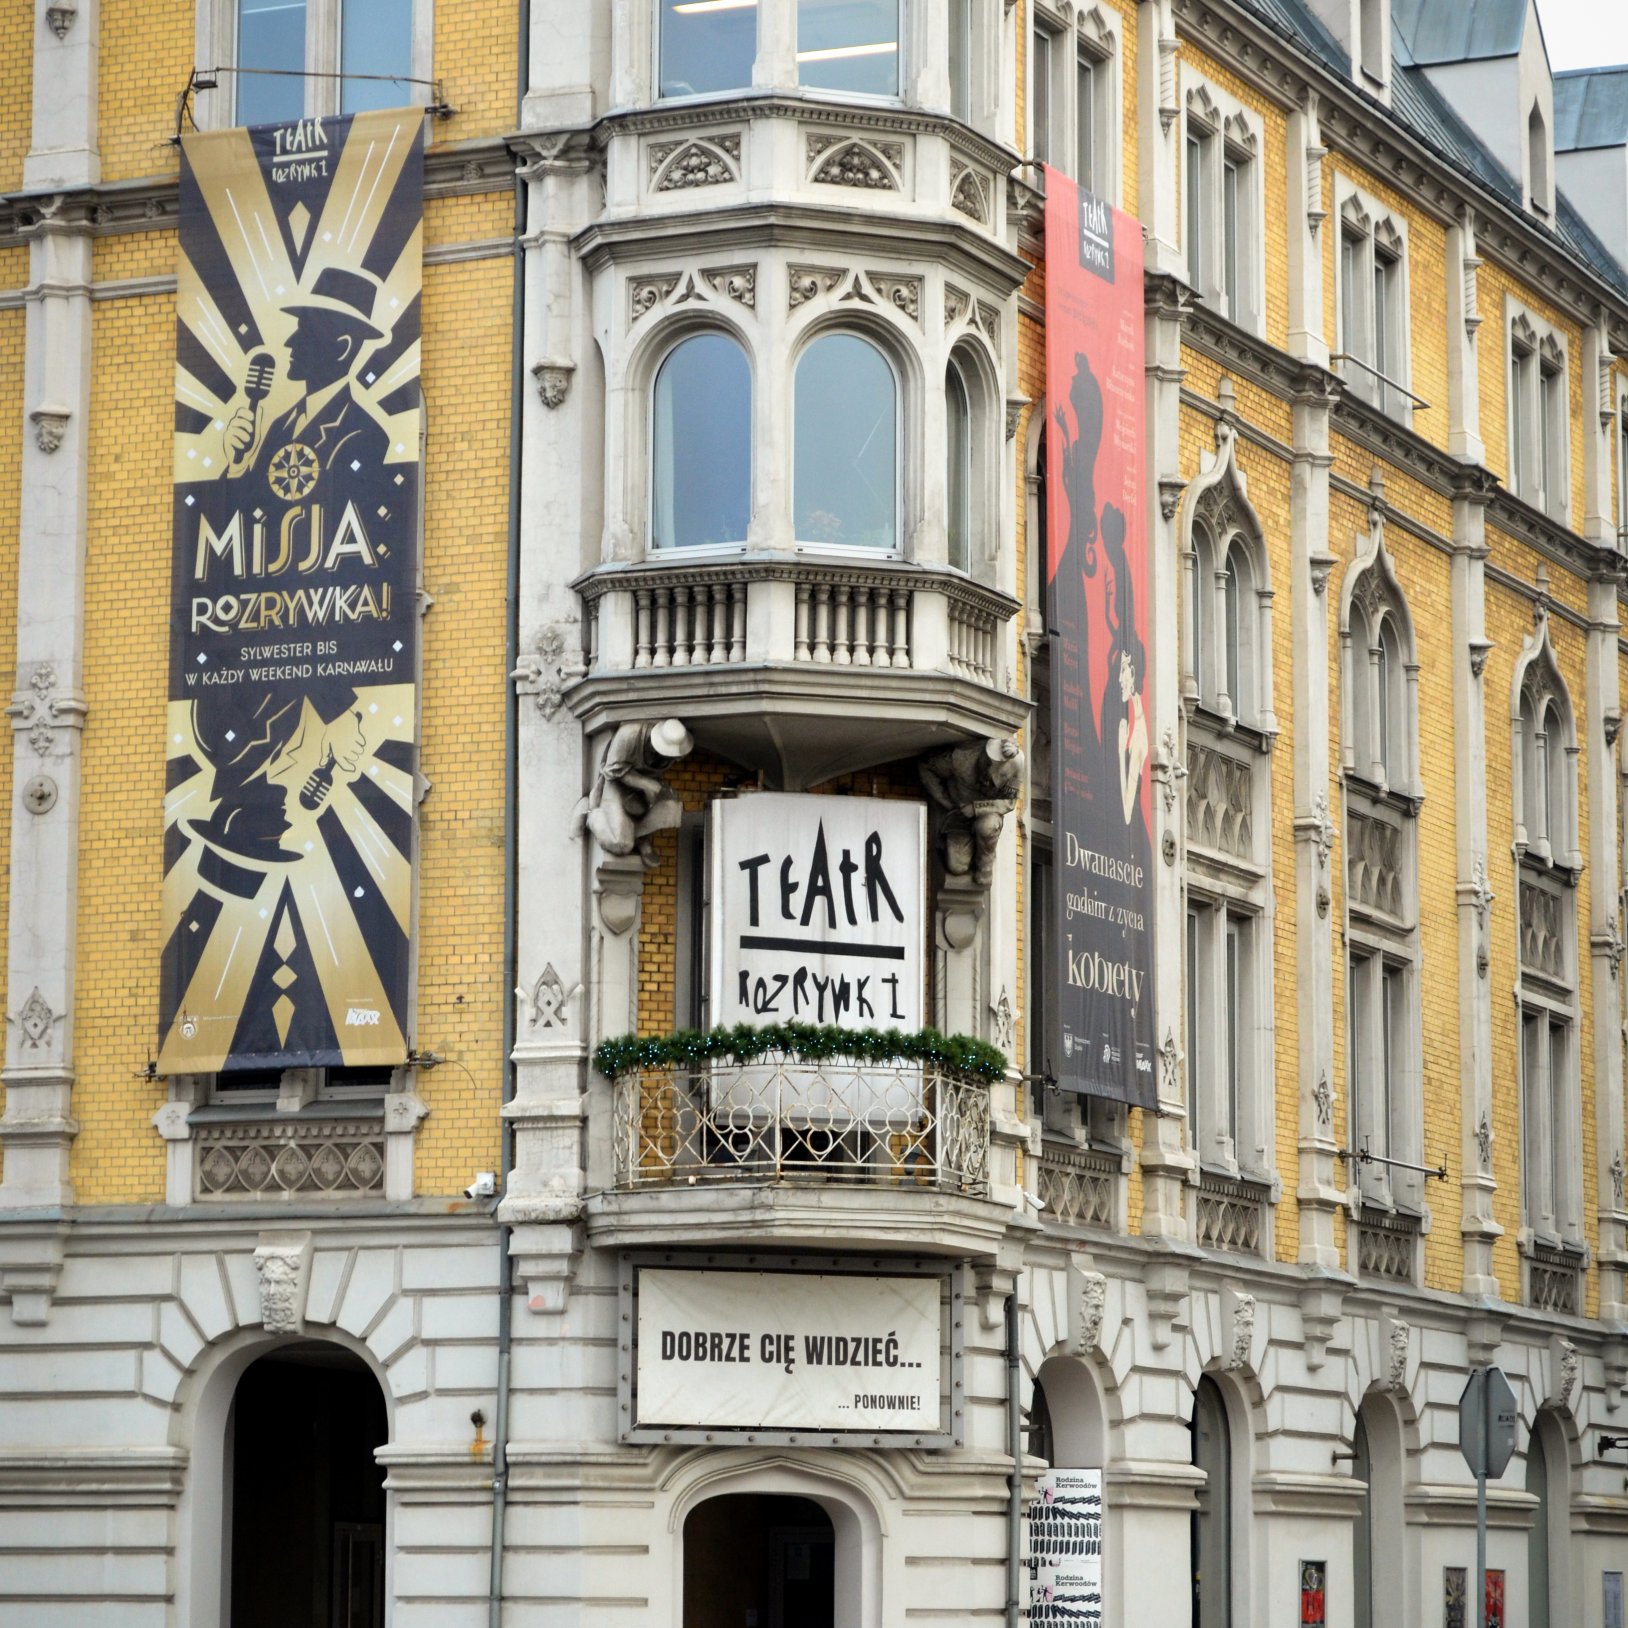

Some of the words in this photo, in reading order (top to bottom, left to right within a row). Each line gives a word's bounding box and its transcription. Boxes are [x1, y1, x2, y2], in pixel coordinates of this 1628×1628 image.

[191, 582, 391, 635] ROZRYWKA!
[185, 672, 198, 686] W
[202, 667, 245, 686] KAŻDY
[249, 664, 312, 682] WEEKEND
[317, 657, 394, 677] KARNAWAŁU
[240, 642, 312, 661] SYLWESTER
[317, 640, 337, 655] BIS
[738, 816, 905, 930] TEATR
[738, 965, 906, 1025] ROZRYWKI
[1066, 933, 1145, 1019] kobiety
[661, 1330, 751, 1363] DOBRZE
[760, 1333, 796, 1375] CIĘ
[804, 1330, 922, 1368] WIDZIEĆ...
